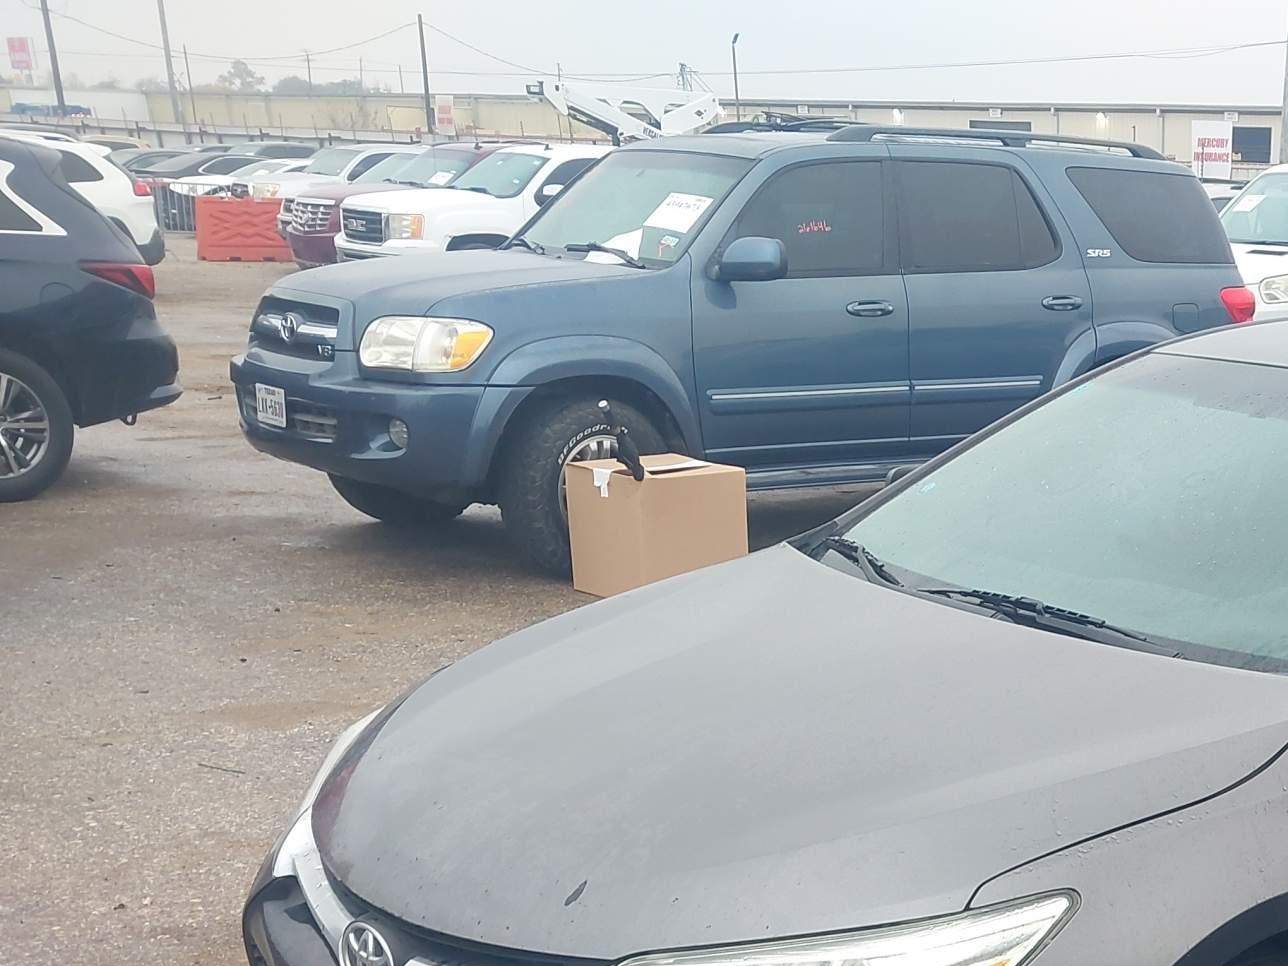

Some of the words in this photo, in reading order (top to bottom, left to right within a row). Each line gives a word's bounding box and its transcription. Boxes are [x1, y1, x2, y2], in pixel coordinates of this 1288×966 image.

[1197, 137, 1229, 148] MERCURY
[1087, 249, 1111, 257] SR5
[557, 423, 629, 466] BFGoodrh
